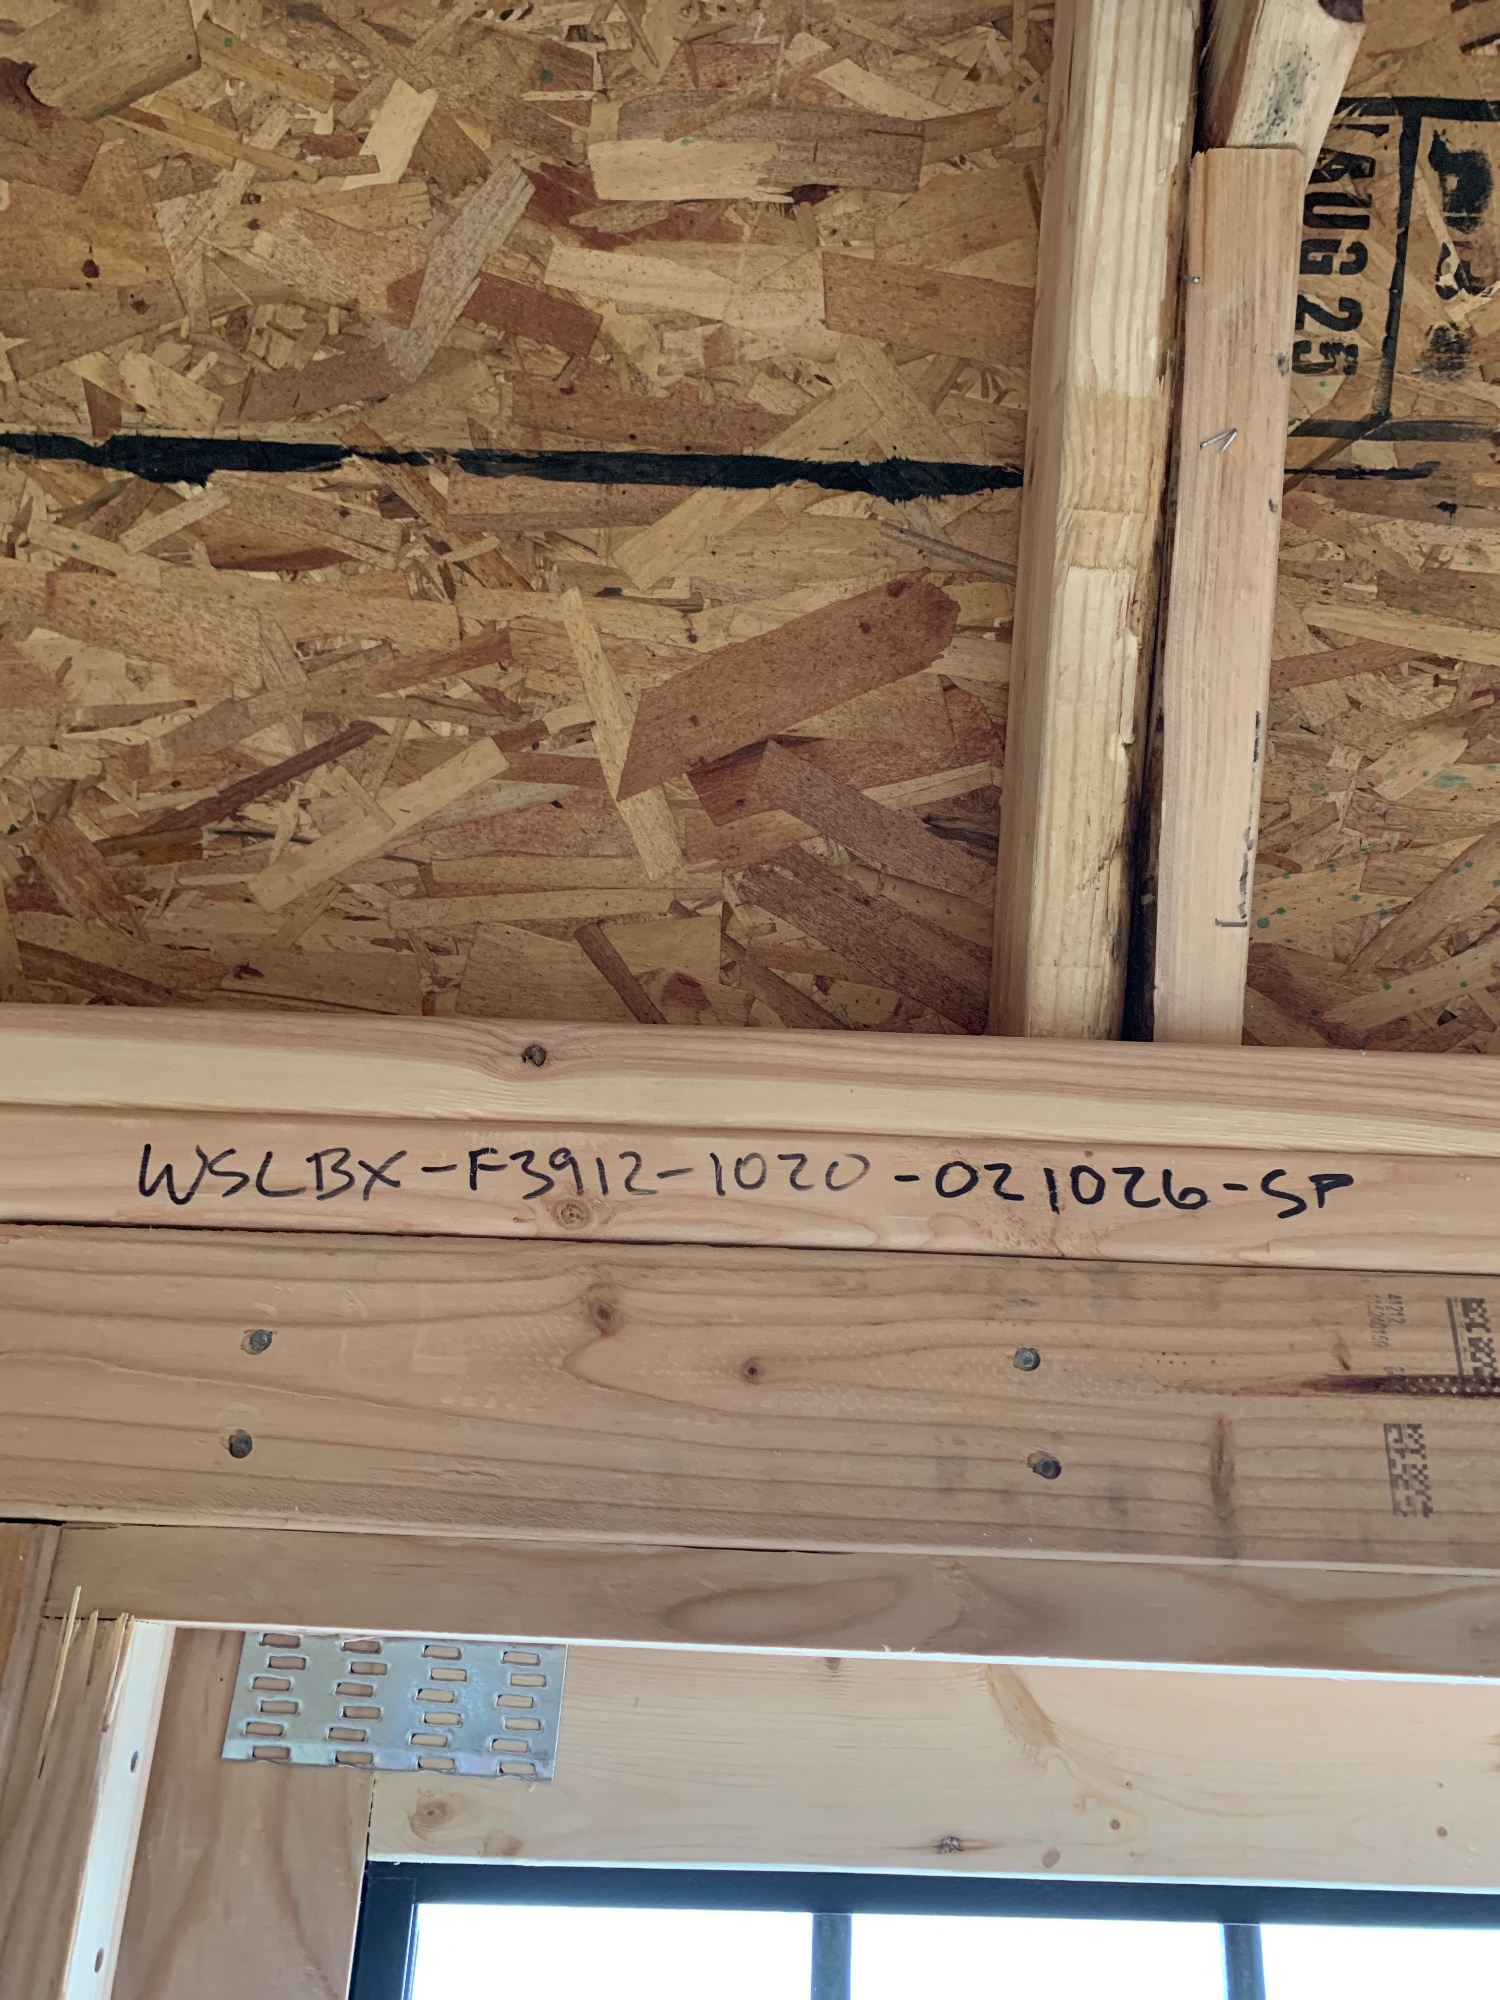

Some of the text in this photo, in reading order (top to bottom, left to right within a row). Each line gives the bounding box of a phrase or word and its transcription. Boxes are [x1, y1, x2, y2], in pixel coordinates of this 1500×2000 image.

[1299, 148, 1376, 276] AUG
[1292, 294, 1364, 376] 25
[138, 1143, 1354, 1219] WSLBX-F3912-1020-021026-SP
